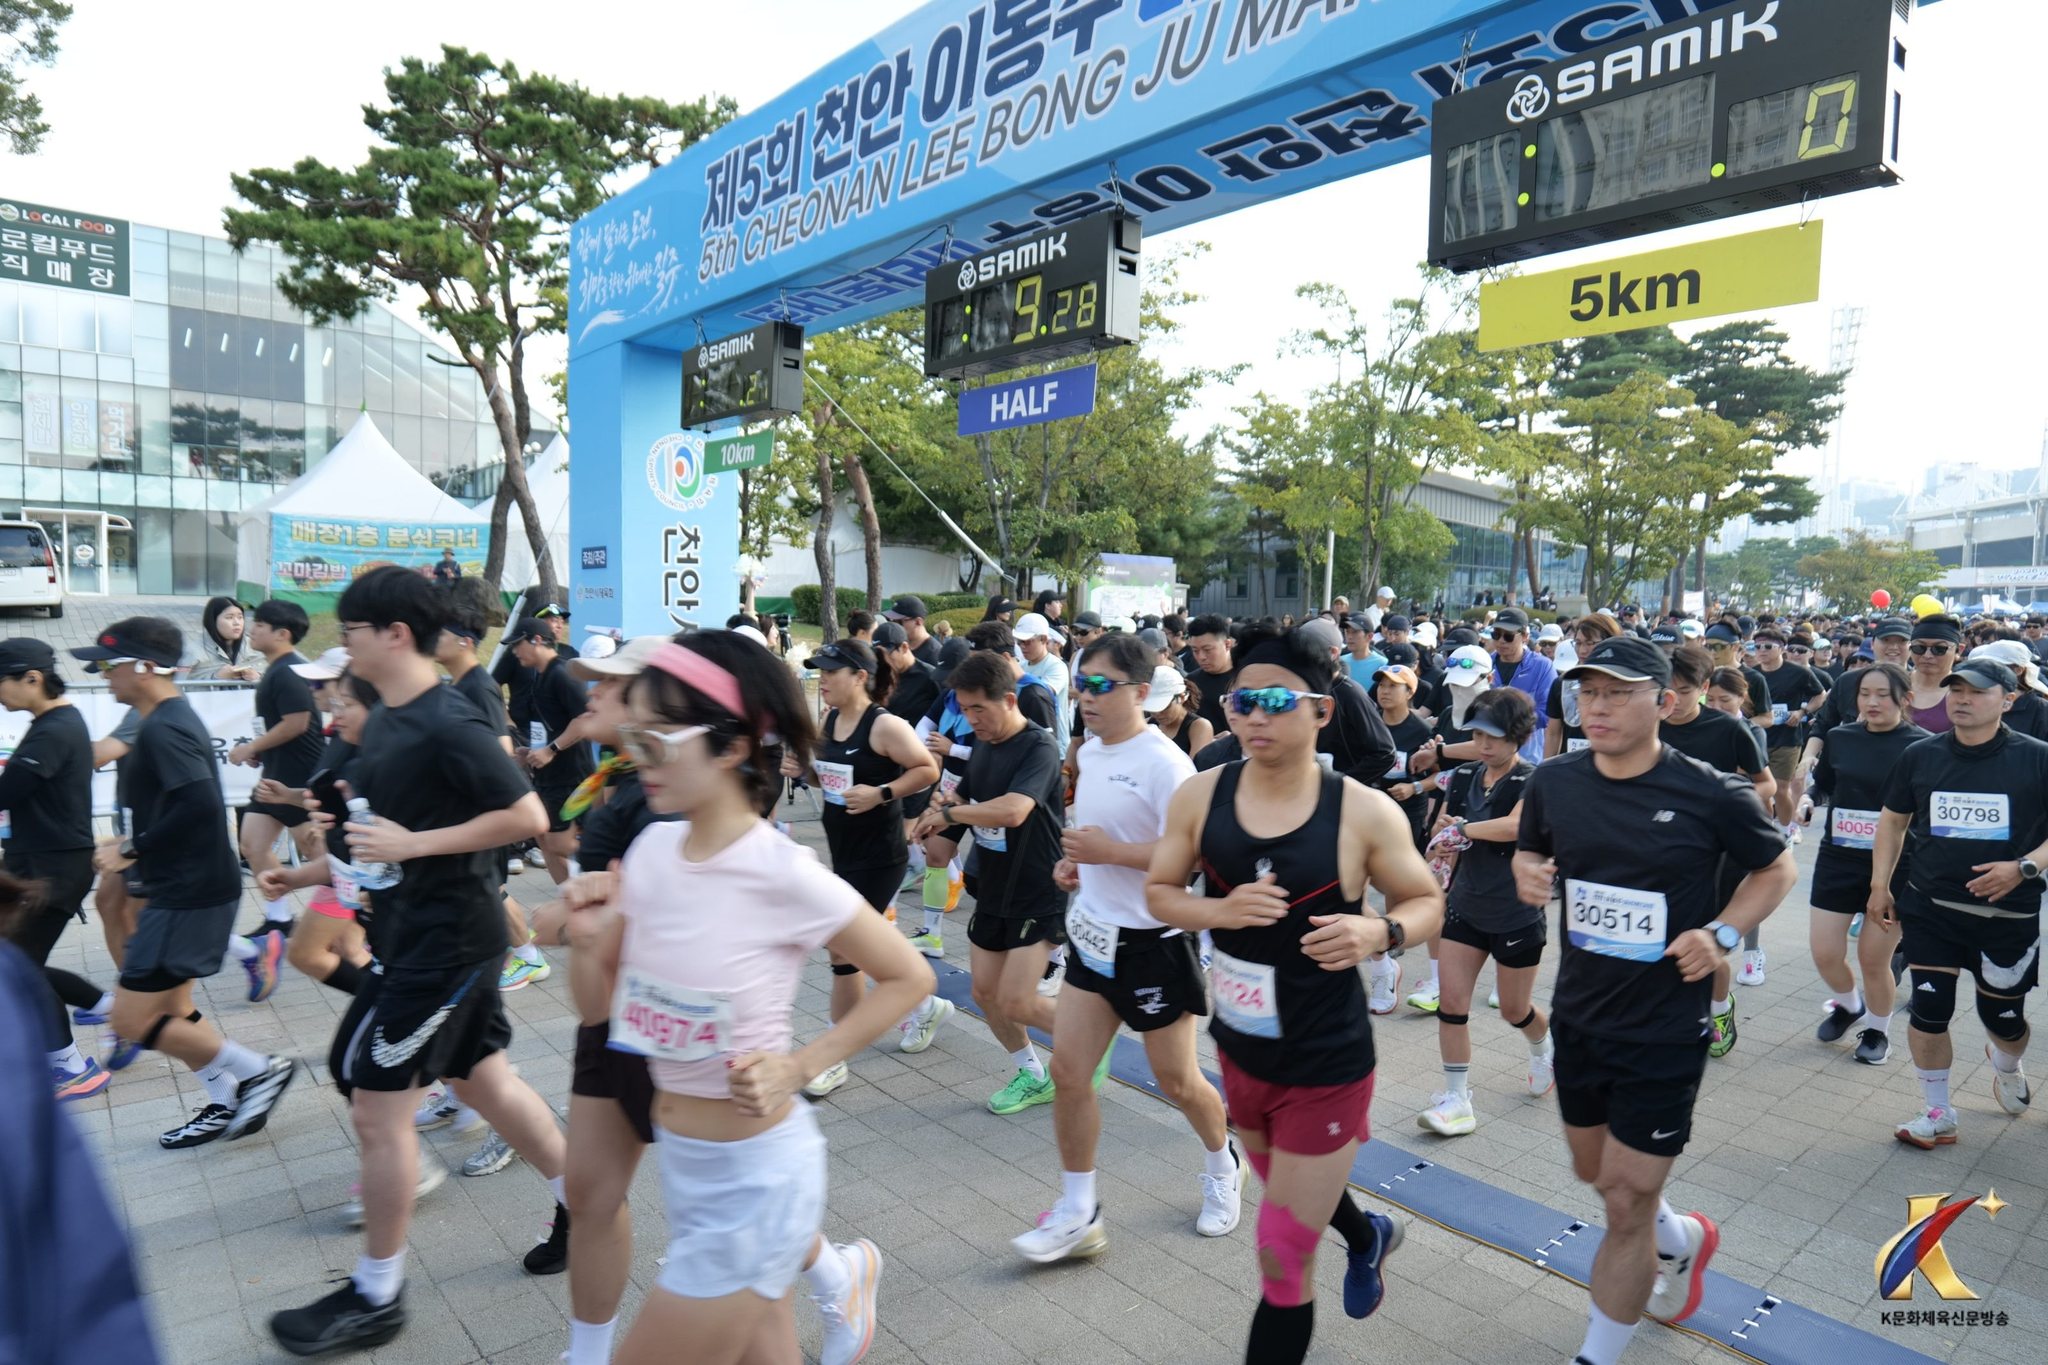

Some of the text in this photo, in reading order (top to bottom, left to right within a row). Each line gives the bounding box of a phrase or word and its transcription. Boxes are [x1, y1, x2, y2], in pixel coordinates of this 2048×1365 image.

[1556, 1, 1780, 104] SAMIK
[698, 231, 738, 280] 5th
[744, 151, 898, 262] CHEONAN
[900, 115, 977, 196] LEE
[978, 49, 1126, 163] BONG
[1135, 0, 1219, 96] JU
[701, 111, 806, 234] 제5회
[813, 49, 913, 182] 천안
[22, 209, 116, 235] LOCAL FOOD
[1, 227, 116, 265] 로컬푸드
[978, 231, 1068, 282] SAMIK
[1569, 268, 1701, 323] 5km
[709, 332, 755, 363] SAMIK
[990, 381, 1059, 423] HALF
[721, 443, 756, 466] 10km
[291, 520, 478, 549] 매장1층 분식코너
[1837, 820, 1878, 835] 4005
[1937, 806, 2000, 823] 30798
[1574, 902, 1654, 935] 30514
